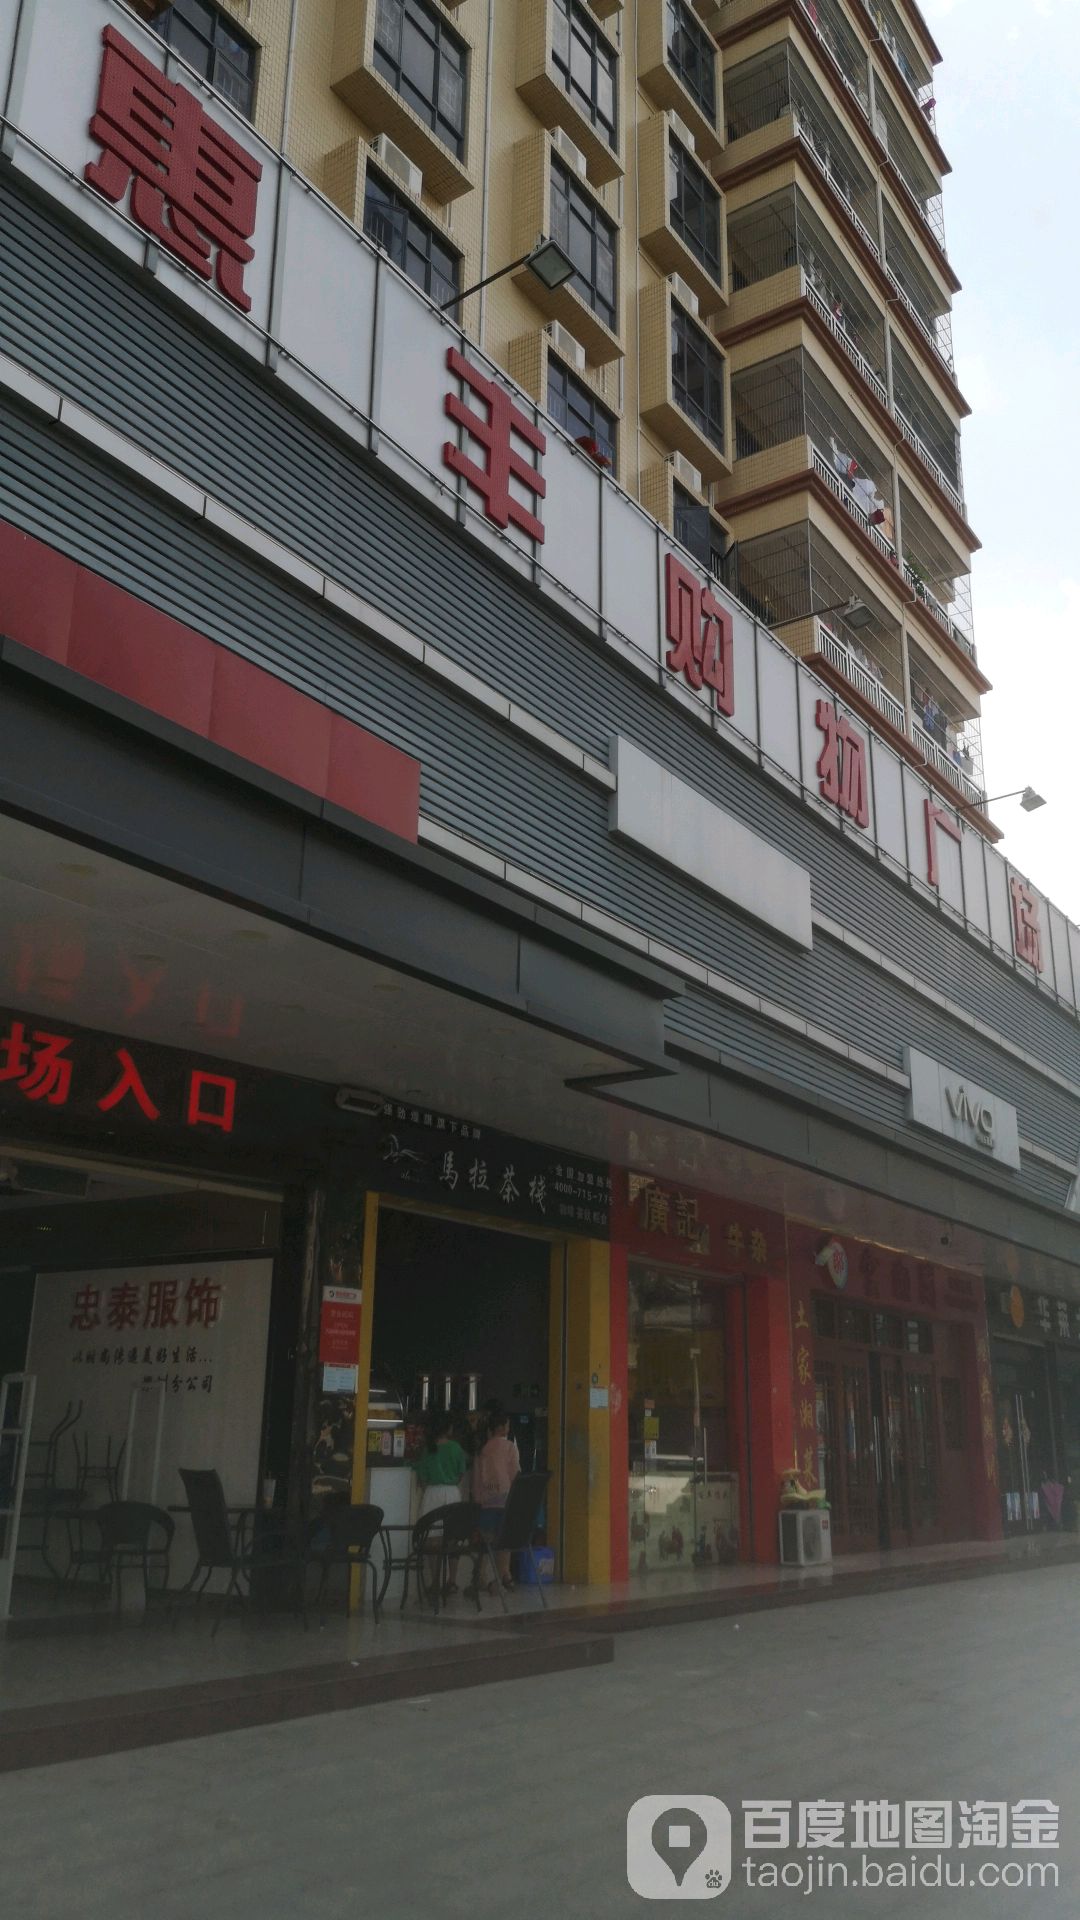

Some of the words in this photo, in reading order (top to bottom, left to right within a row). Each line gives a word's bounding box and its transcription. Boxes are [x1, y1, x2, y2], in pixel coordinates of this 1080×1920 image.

[0, 1022, 237, 1132] 场入口
[945, 1085, 994, 1137] vivo
[68, 1277, 222, 1331] 忠泰服饰
